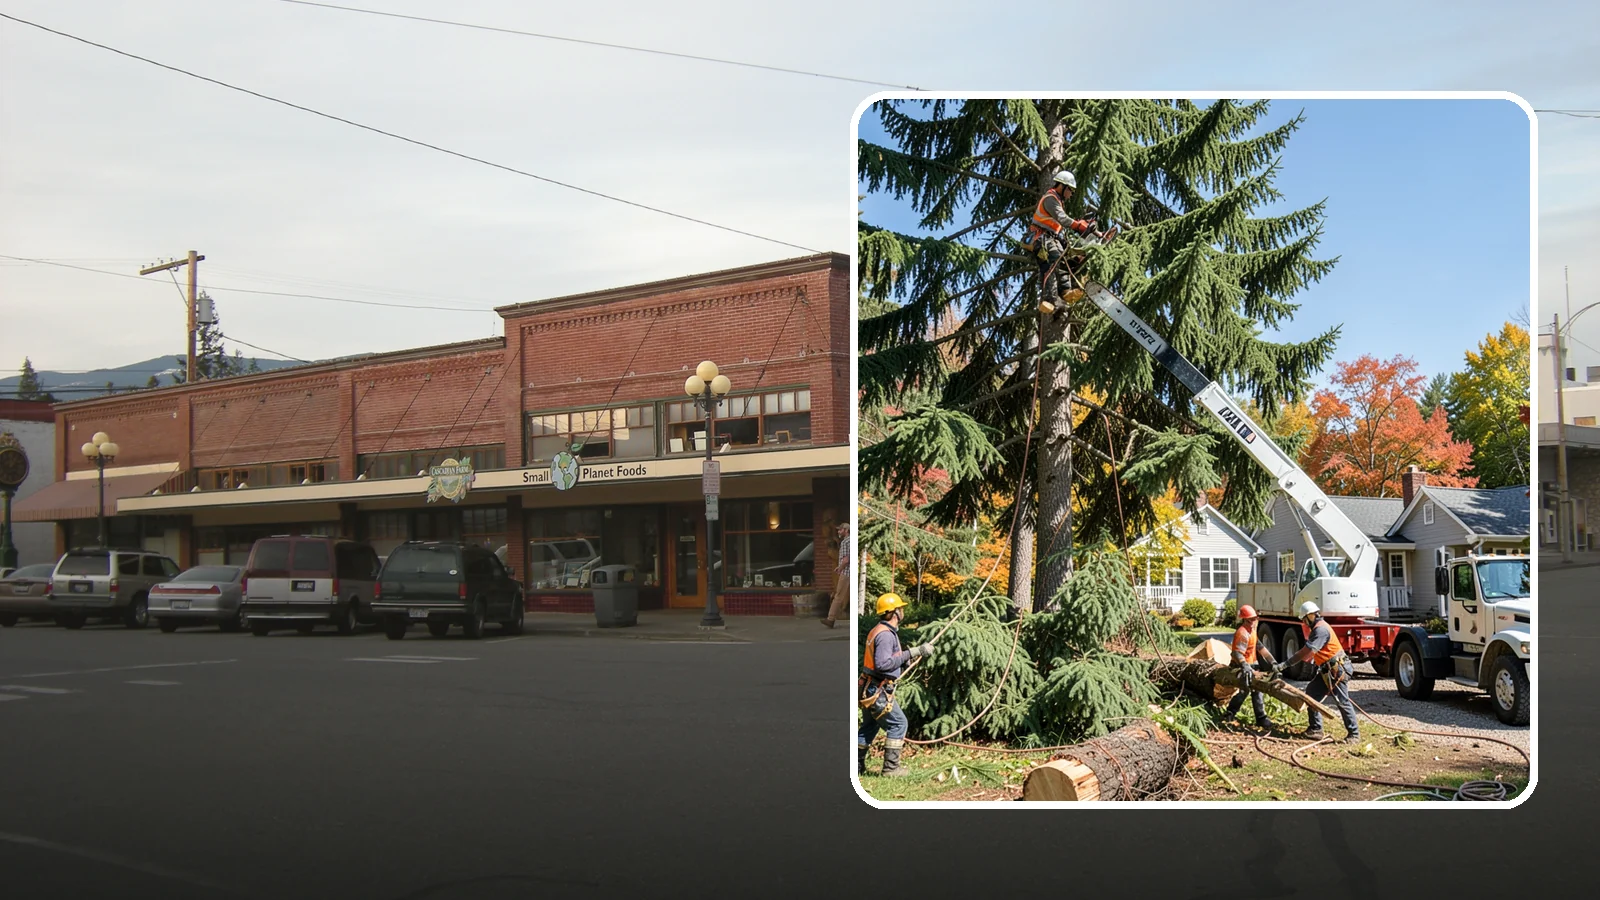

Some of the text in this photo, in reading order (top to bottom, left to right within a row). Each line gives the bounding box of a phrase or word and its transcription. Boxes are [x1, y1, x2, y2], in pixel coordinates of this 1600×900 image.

[523, 464, 647, 483] Small Planet Foods
